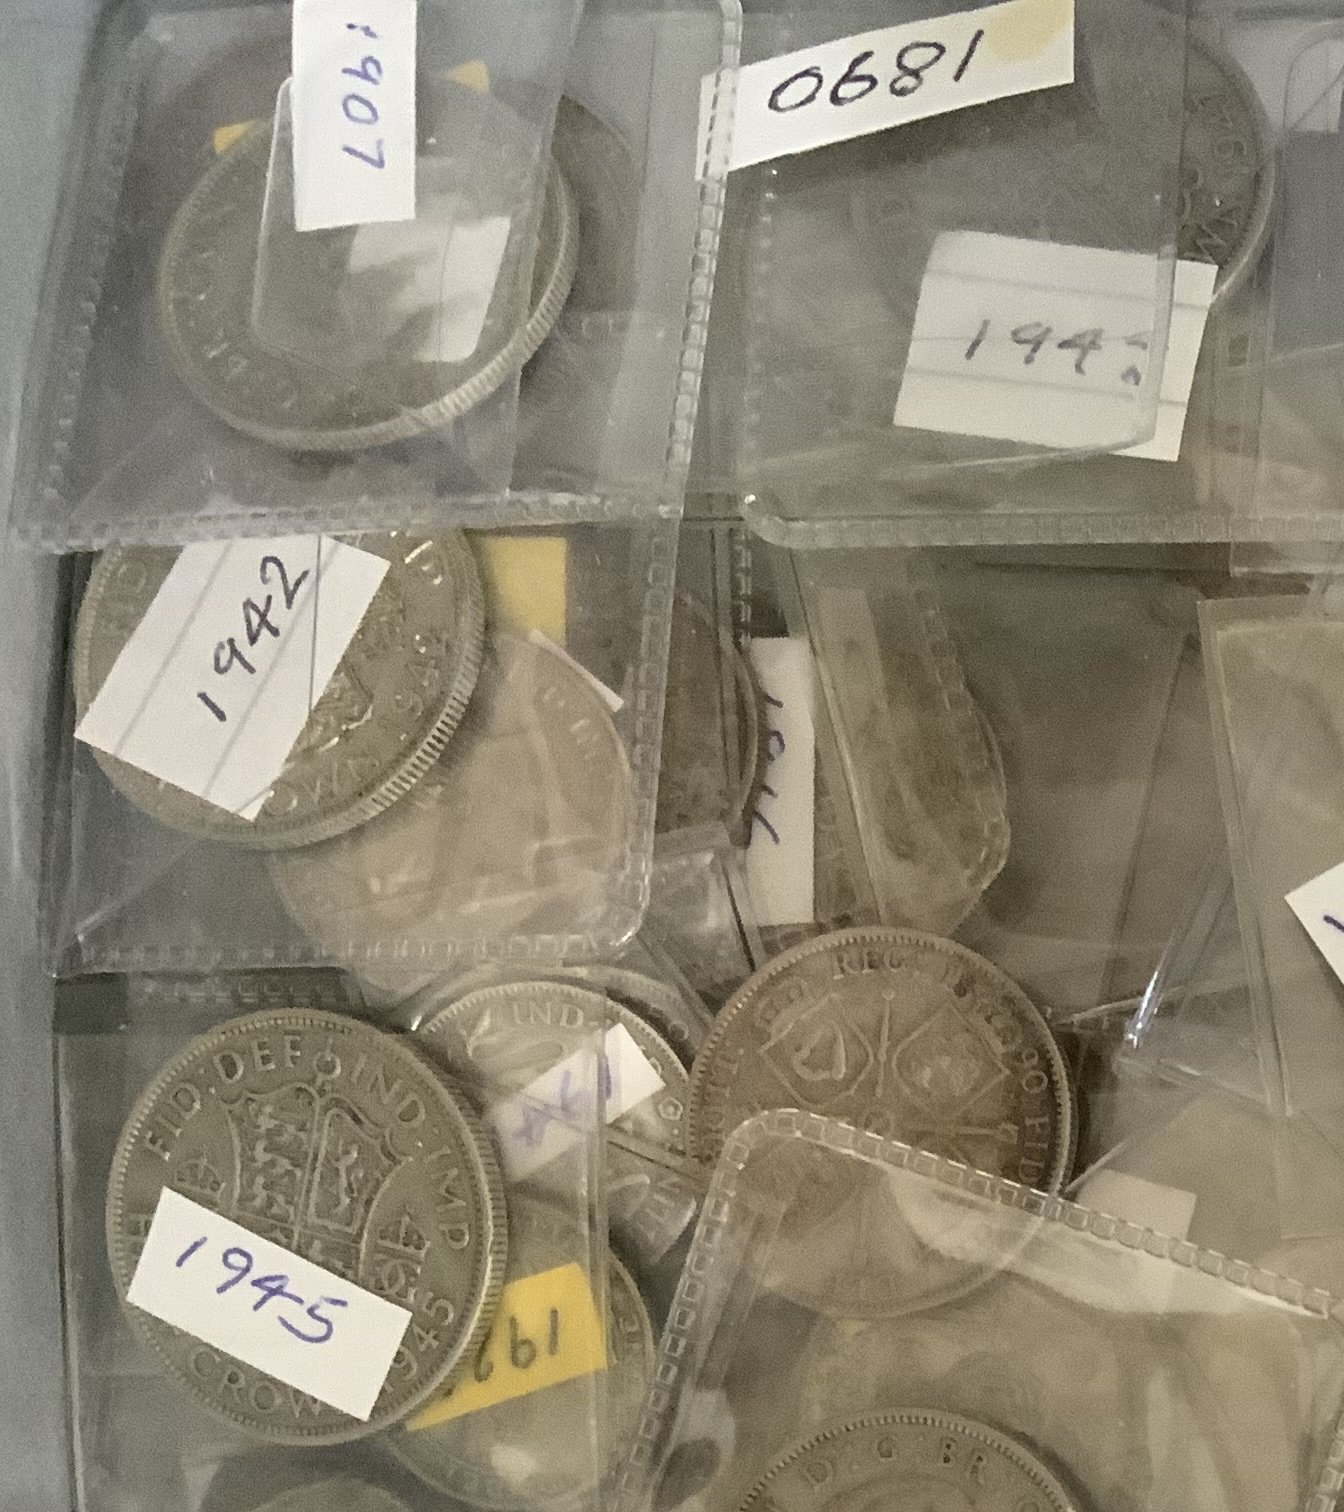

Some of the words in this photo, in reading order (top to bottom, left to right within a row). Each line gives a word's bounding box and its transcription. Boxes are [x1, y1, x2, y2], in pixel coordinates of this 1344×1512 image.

[341, 22, 386, 170] 1907
[768, 29, 984, 114] 1890
[197, 555, 309, 722] 1942
[175, 1235, 350, 1345] 1945
